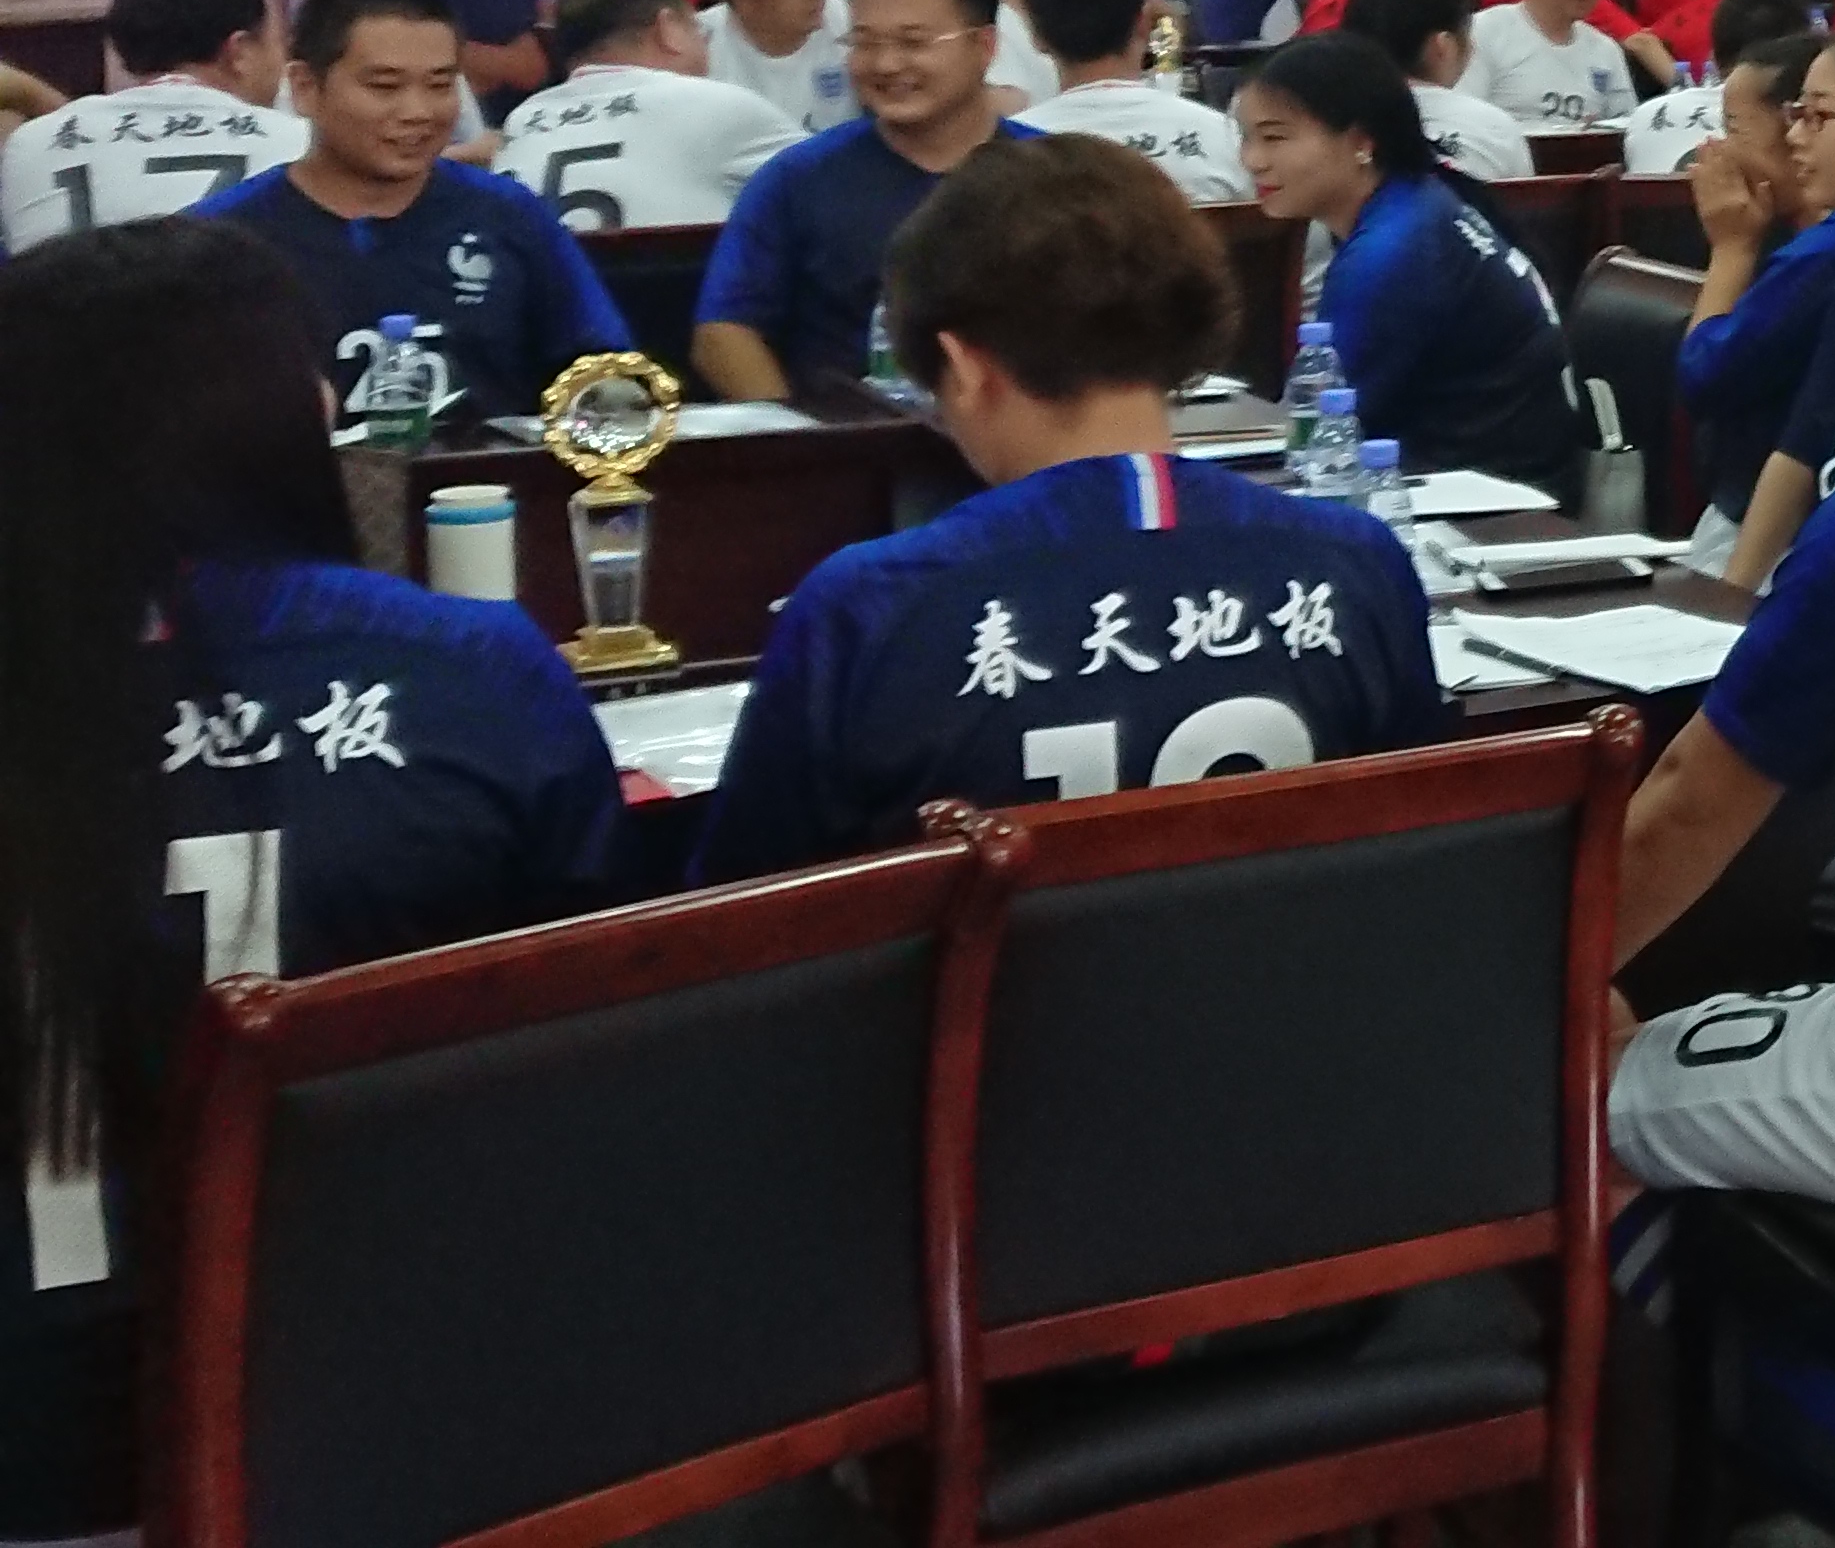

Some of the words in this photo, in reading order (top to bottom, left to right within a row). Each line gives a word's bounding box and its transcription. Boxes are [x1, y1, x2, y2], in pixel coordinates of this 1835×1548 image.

[53, 112, 268, 152] 春天地板
[956, 580, 1344, 700] 春天地板
[160, 679, 407, 774] 地板
